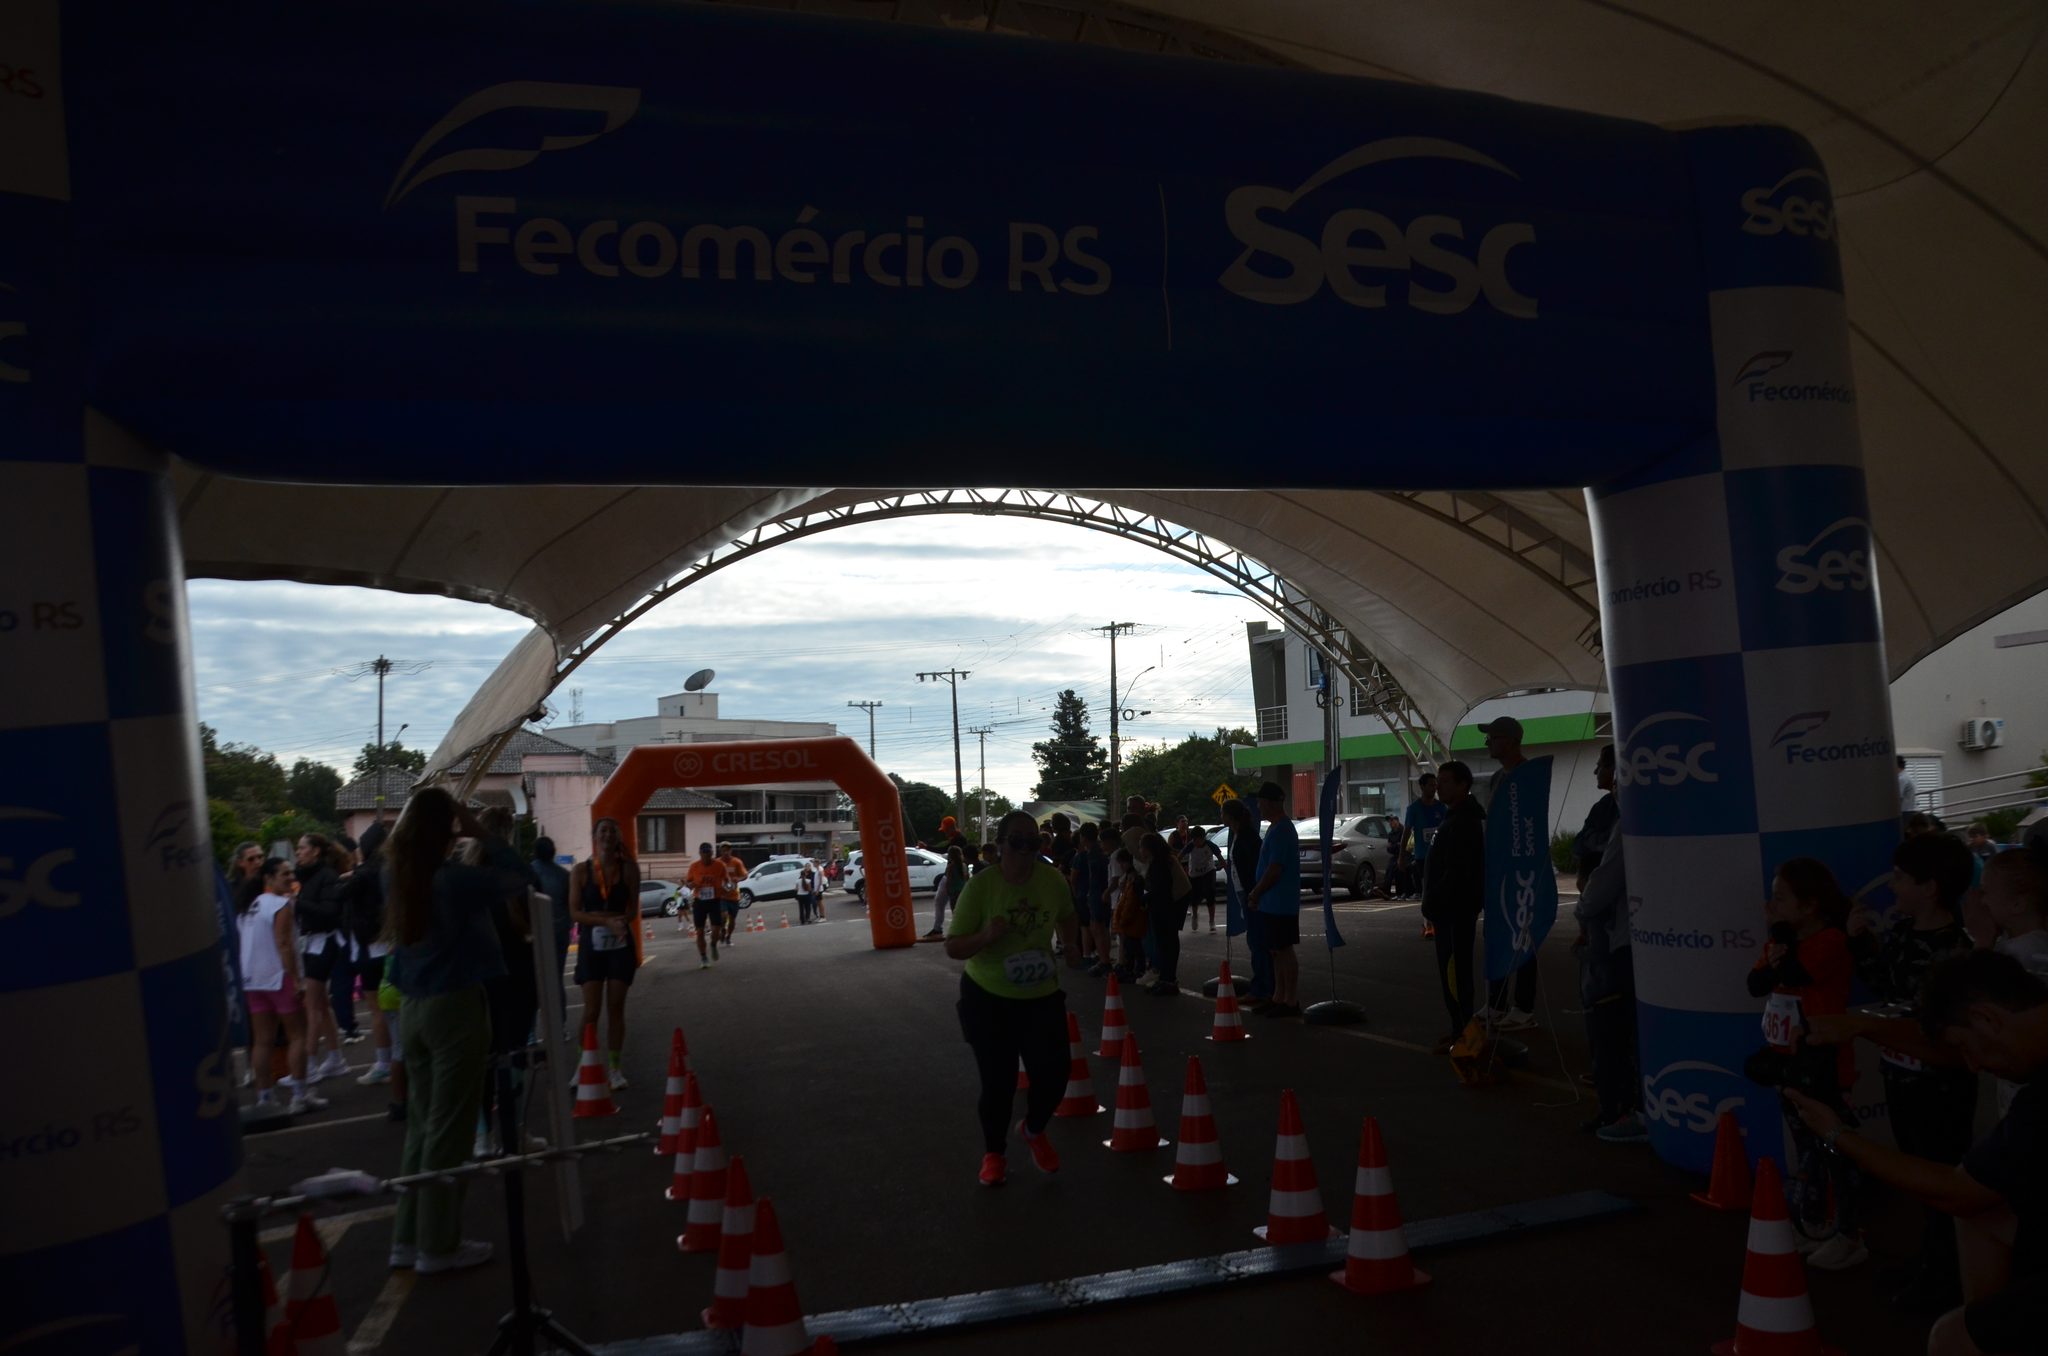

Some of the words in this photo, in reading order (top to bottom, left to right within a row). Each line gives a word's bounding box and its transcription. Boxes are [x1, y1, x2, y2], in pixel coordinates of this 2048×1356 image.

[454, 196, 979, 289] Fecomércio
[1007, 222, 1113, 296] RS
[1217, 180, 1539, 319] Sesc
[1687, 569, 1722, 592] RS
[711, 749, 819, 773] CRESOL
[879, 814, 901, 899] CRESOL
[1720, 918, 1757, 950] RS
[1012, 961, 1050, 986] 222
